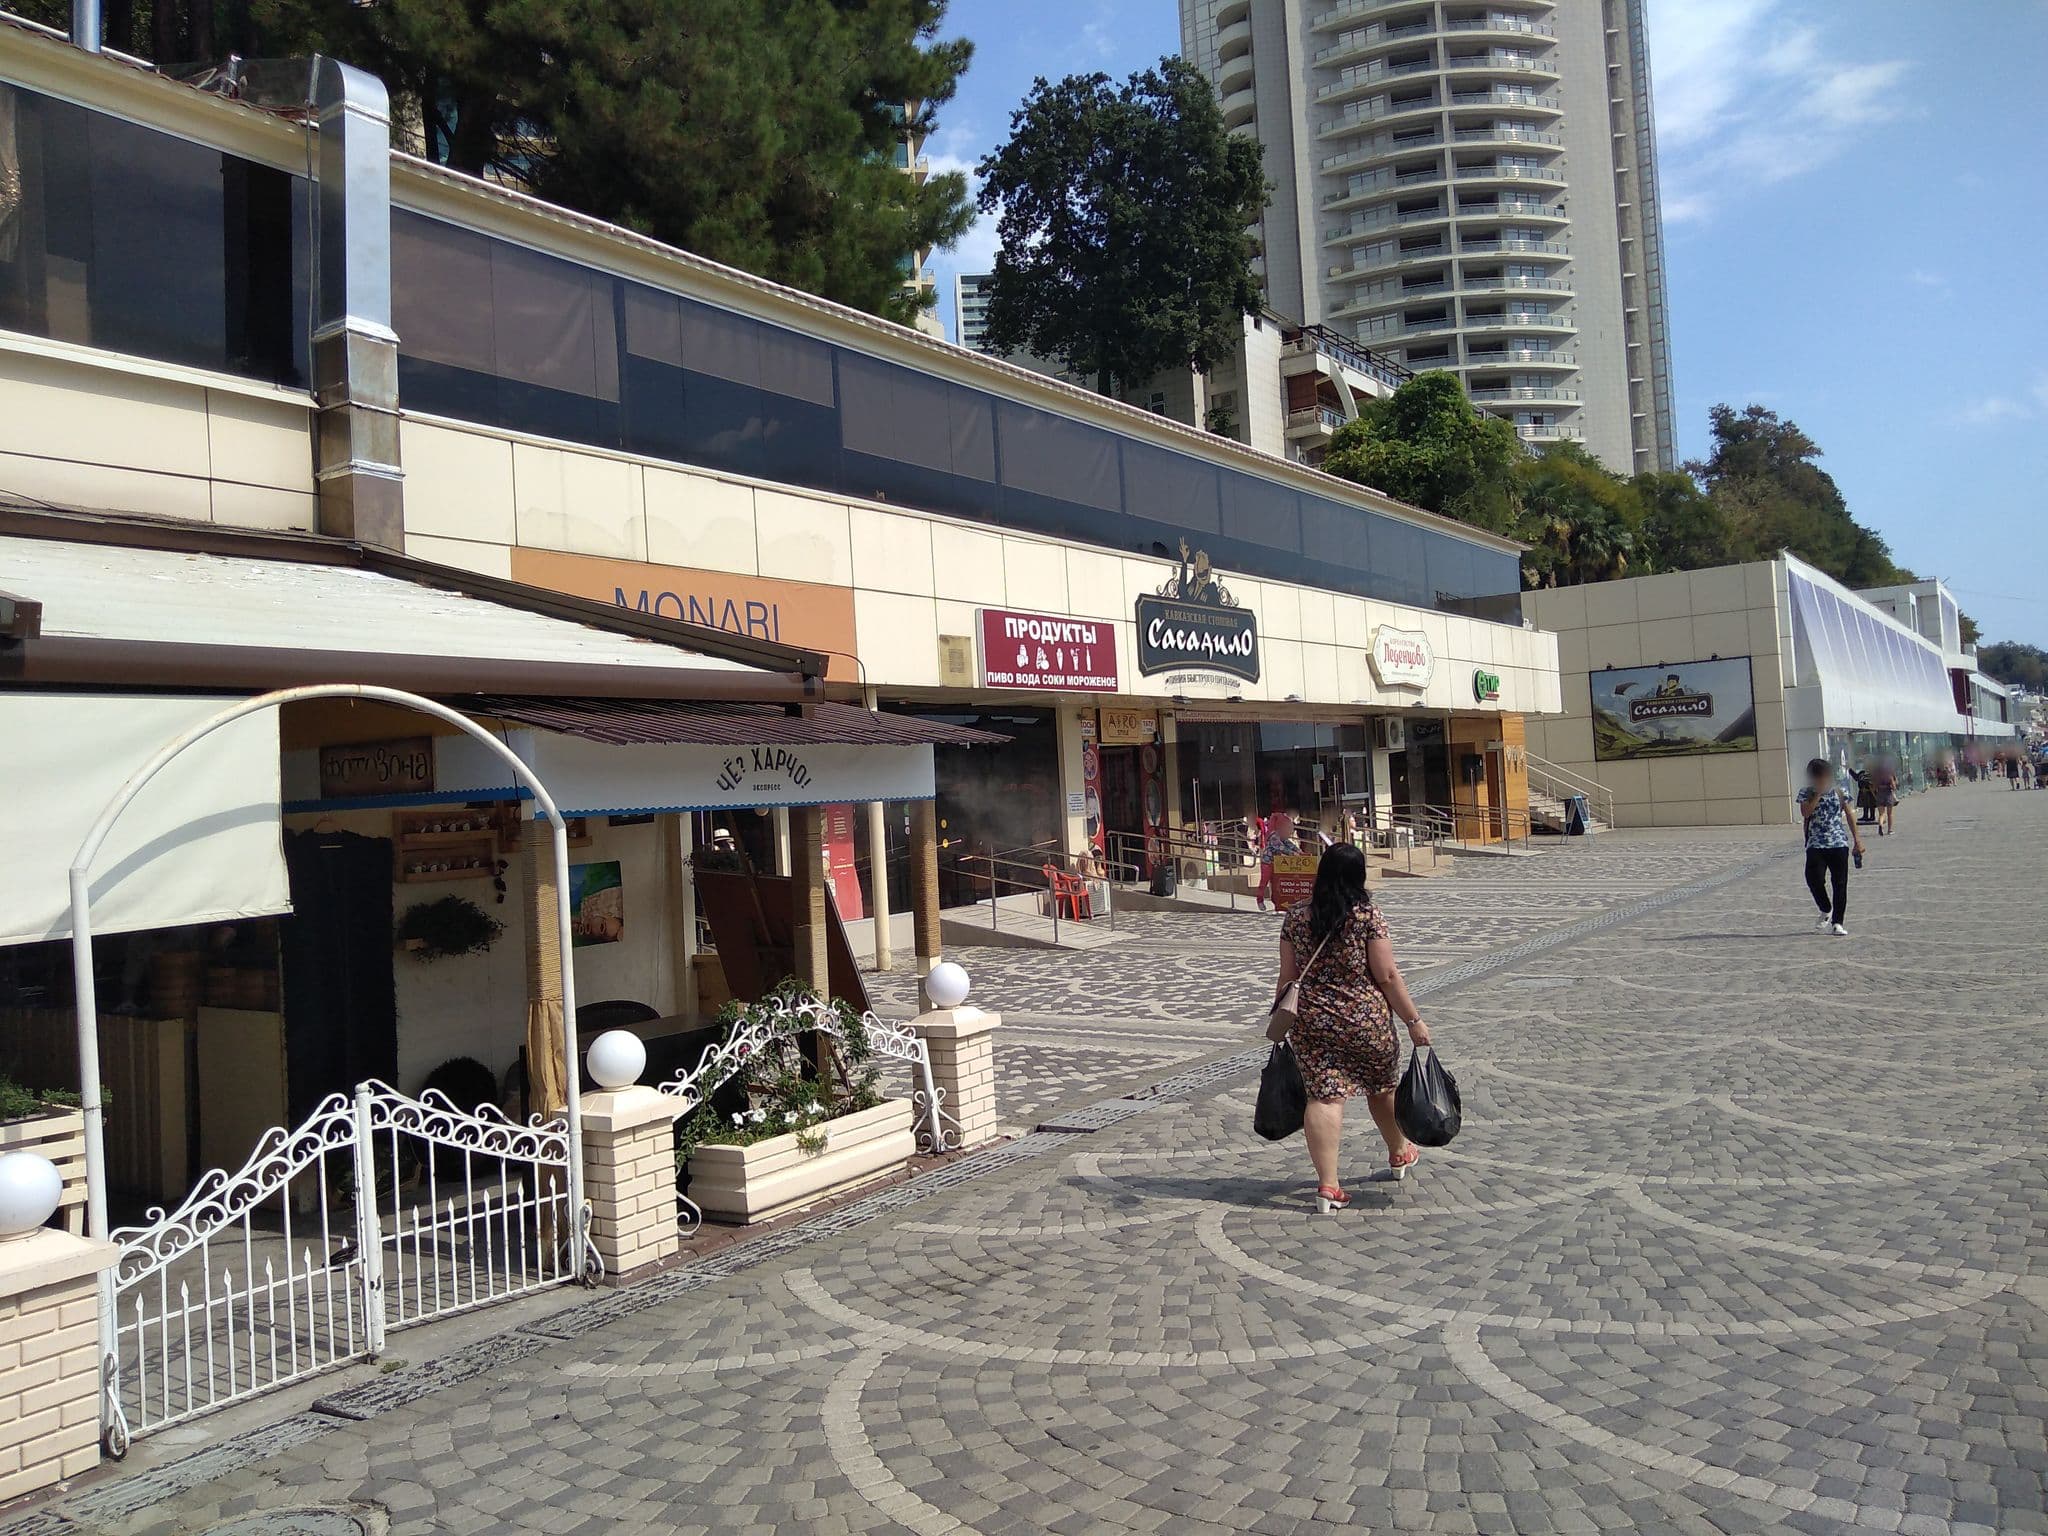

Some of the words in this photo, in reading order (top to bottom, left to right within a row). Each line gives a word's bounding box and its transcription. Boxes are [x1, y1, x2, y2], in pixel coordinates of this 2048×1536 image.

[1004, 617, 1097, 645] ПРОДУКТЫ
[1147, 617, 1253, 661] Сасадило
[1383, 642, 1426, 670] Леденцово
[987, 671, 1014, 684] ПИВО
[1015, 673, 1041, 686] ВОДА
[1042, 674, 1065, 686] СОКИ
[1066, 675, 1117, 688] МОРОЖЕНОЕ
[1485, 674, 1500, 694] ТИР
[715, 756, 747, 791] ЧЁ?
[751, 746, 812, 789] ХАРЧО!
